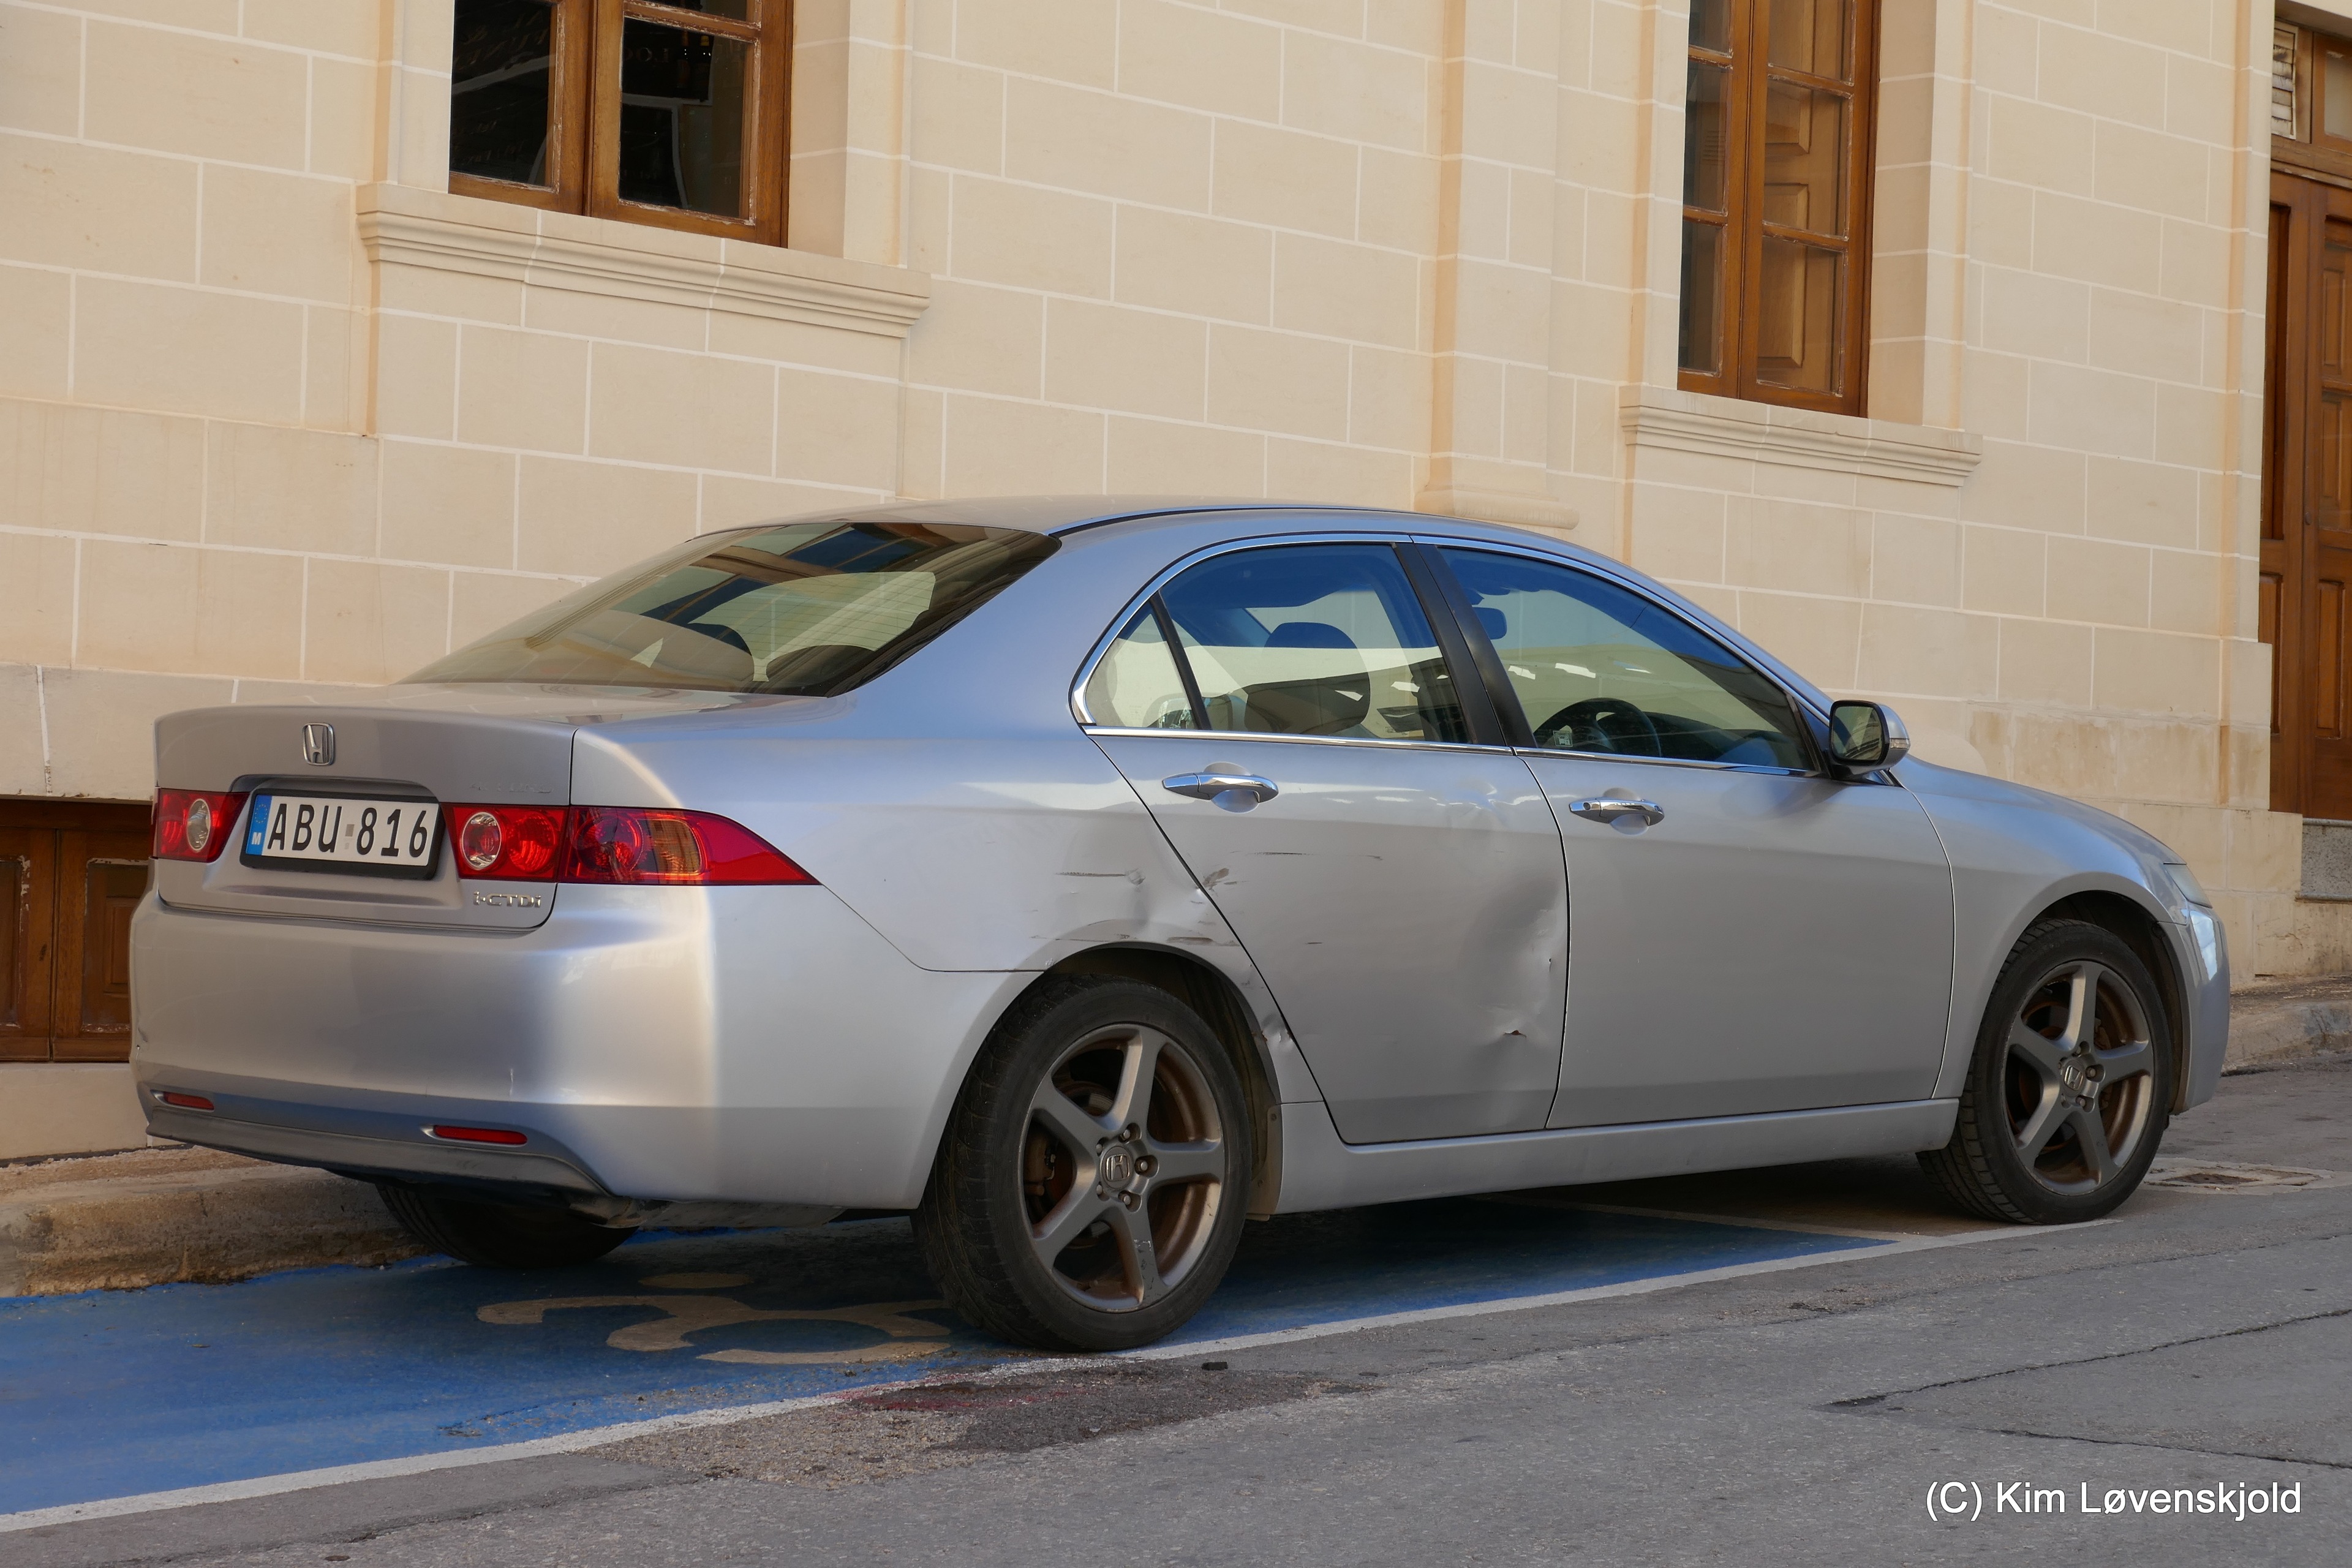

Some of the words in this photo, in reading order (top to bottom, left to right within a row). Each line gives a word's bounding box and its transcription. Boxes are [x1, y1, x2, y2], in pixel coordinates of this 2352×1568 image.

[251, 832, 262, 846] M
[267, 803, 342, 853] ABU
[356, 807, 428, 858] 816
